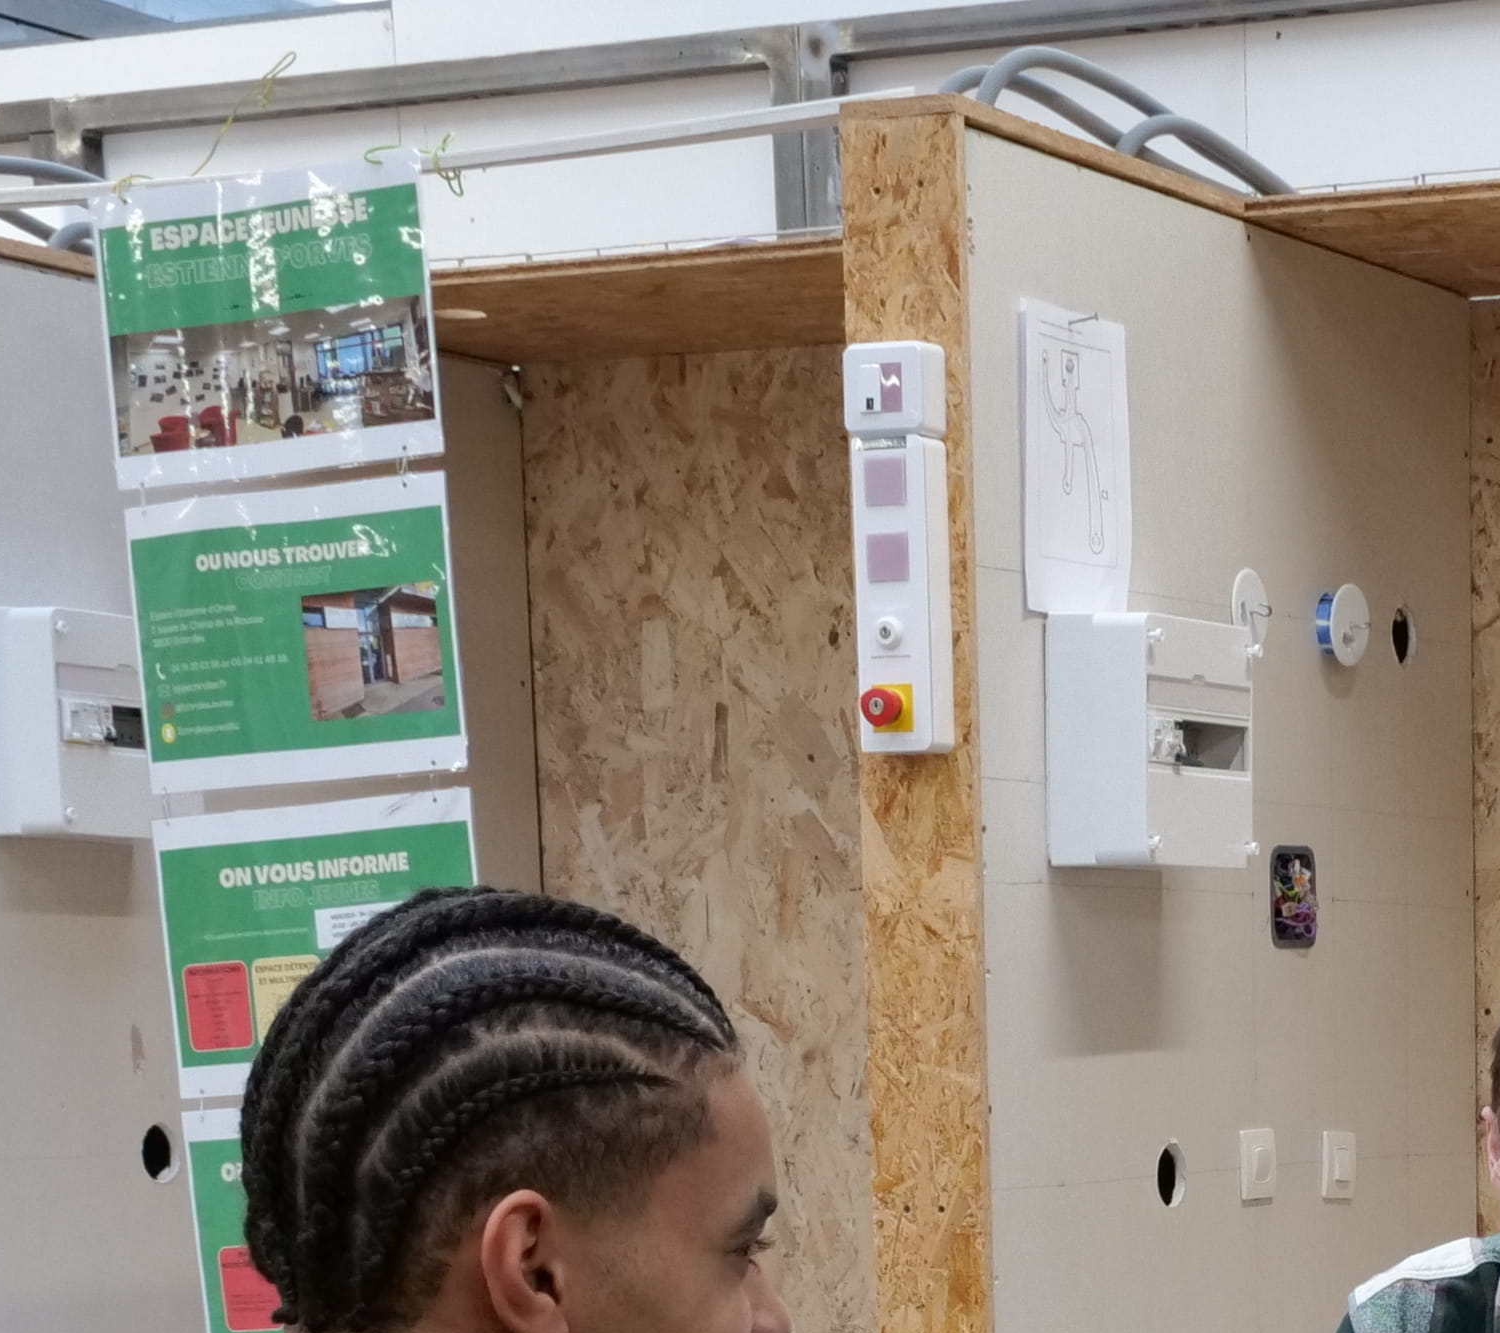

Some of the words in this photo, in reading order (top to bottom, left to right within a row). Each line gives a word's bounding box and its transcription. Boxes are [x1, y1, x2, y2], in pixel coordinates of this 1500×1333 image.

[149, 217, 249, 252] ESPACE
[251, 197, 368, 237] EUNESSE
[146, 253, 258, 289] ESTIENN
[195, 553, 221, 572] OU
[224, 548, 281, 569] NOUS
[282, 539, 370, 564] TROUVER
[219, 866, 252, 888] ON
[254, 861, 316, 885] VOUS
[317, 852, 409, 880] INFORME
[253, 888, 304, 910] INFO
[308, 880, 380, 905] JEUNES
